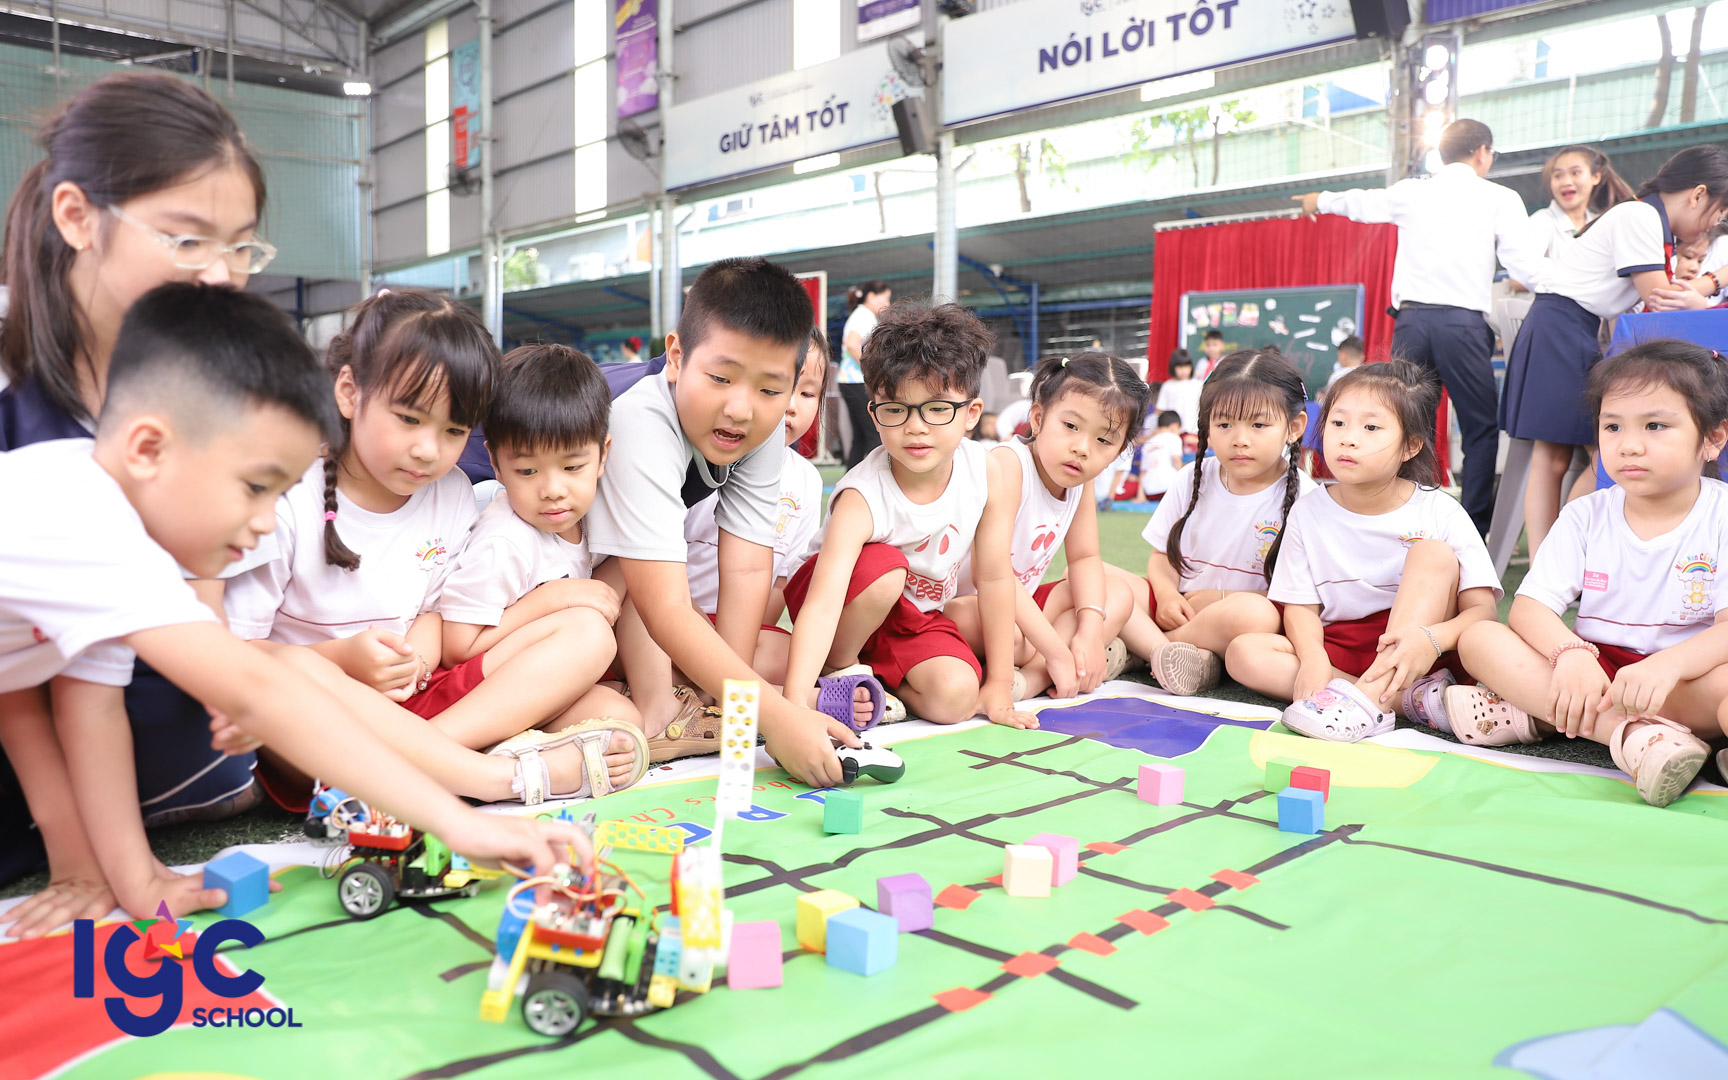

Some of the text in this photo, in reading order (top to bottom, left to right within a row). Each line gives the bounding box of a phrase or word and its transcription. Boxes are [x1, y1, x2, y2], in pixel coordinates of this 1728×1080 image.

[1039, 33, 1092, 73] NÓI
[1103, 17, 1155, 57] LỜI
[720, 94, 849, 153] GIỮ TÂM TỐT
